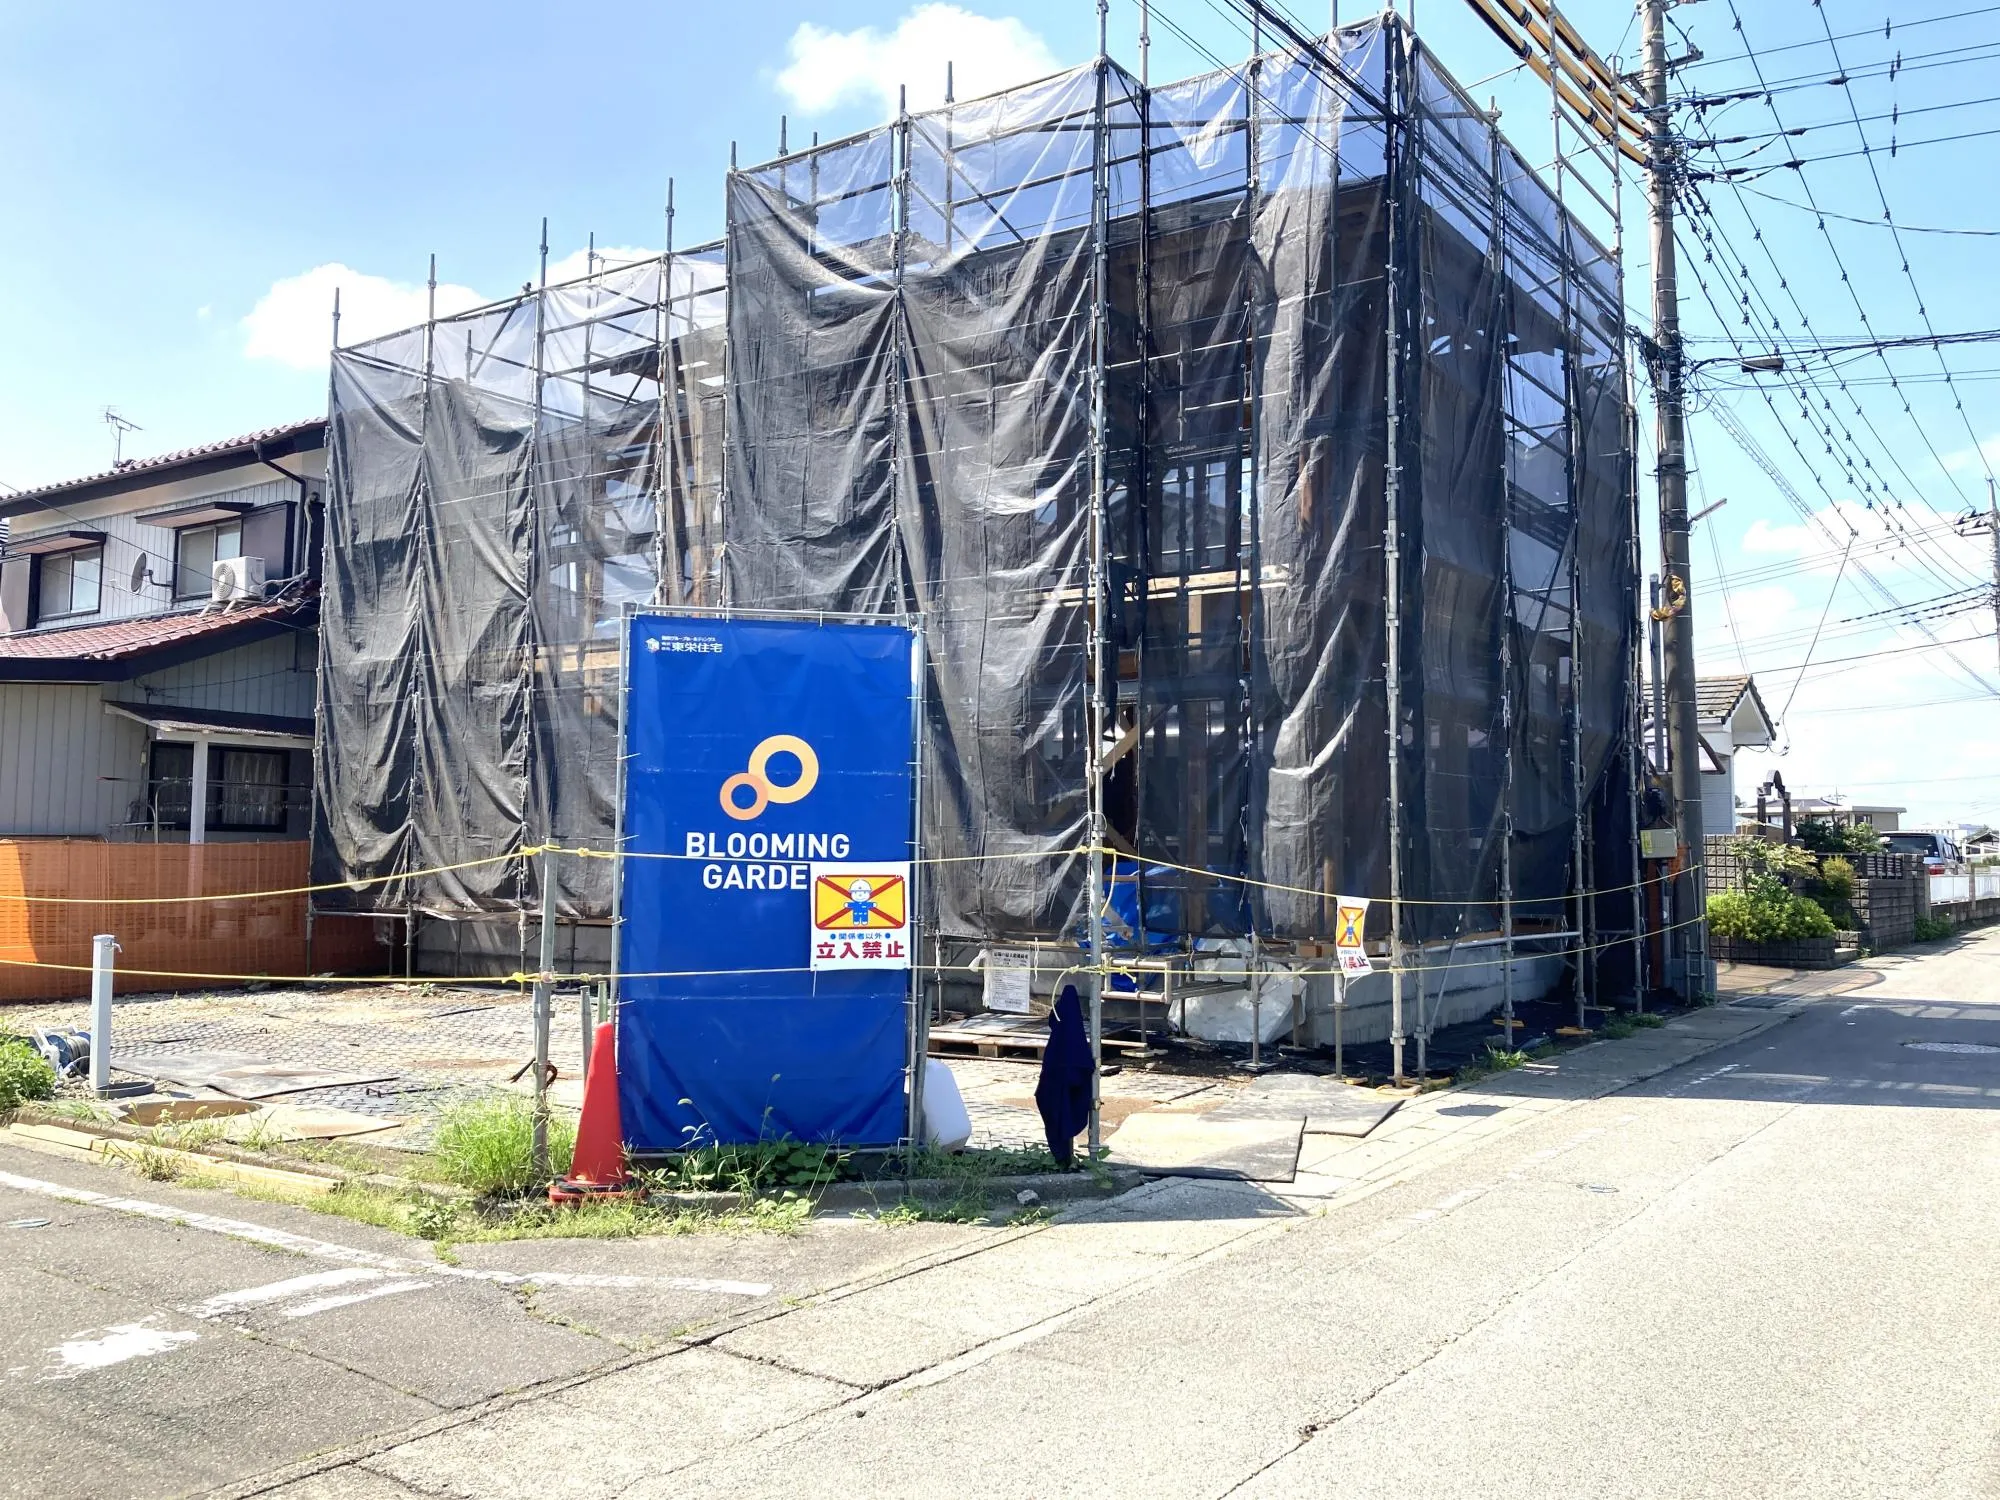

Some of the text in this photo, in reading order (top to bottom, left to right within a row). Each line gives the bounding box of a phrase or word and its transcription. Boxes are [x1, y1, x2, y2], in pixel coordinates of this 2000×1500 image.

[671, 642, 723, 653] 東栄住宅
[686, 831, 850, 858] BLOOMING
[702, 864, 808, 890] GARDE
[838, 932, 883, 941] 関係者以外
[815, 940, 906, 959] 立入禁止
[1340, 955, 1369, 969] 入禁止
